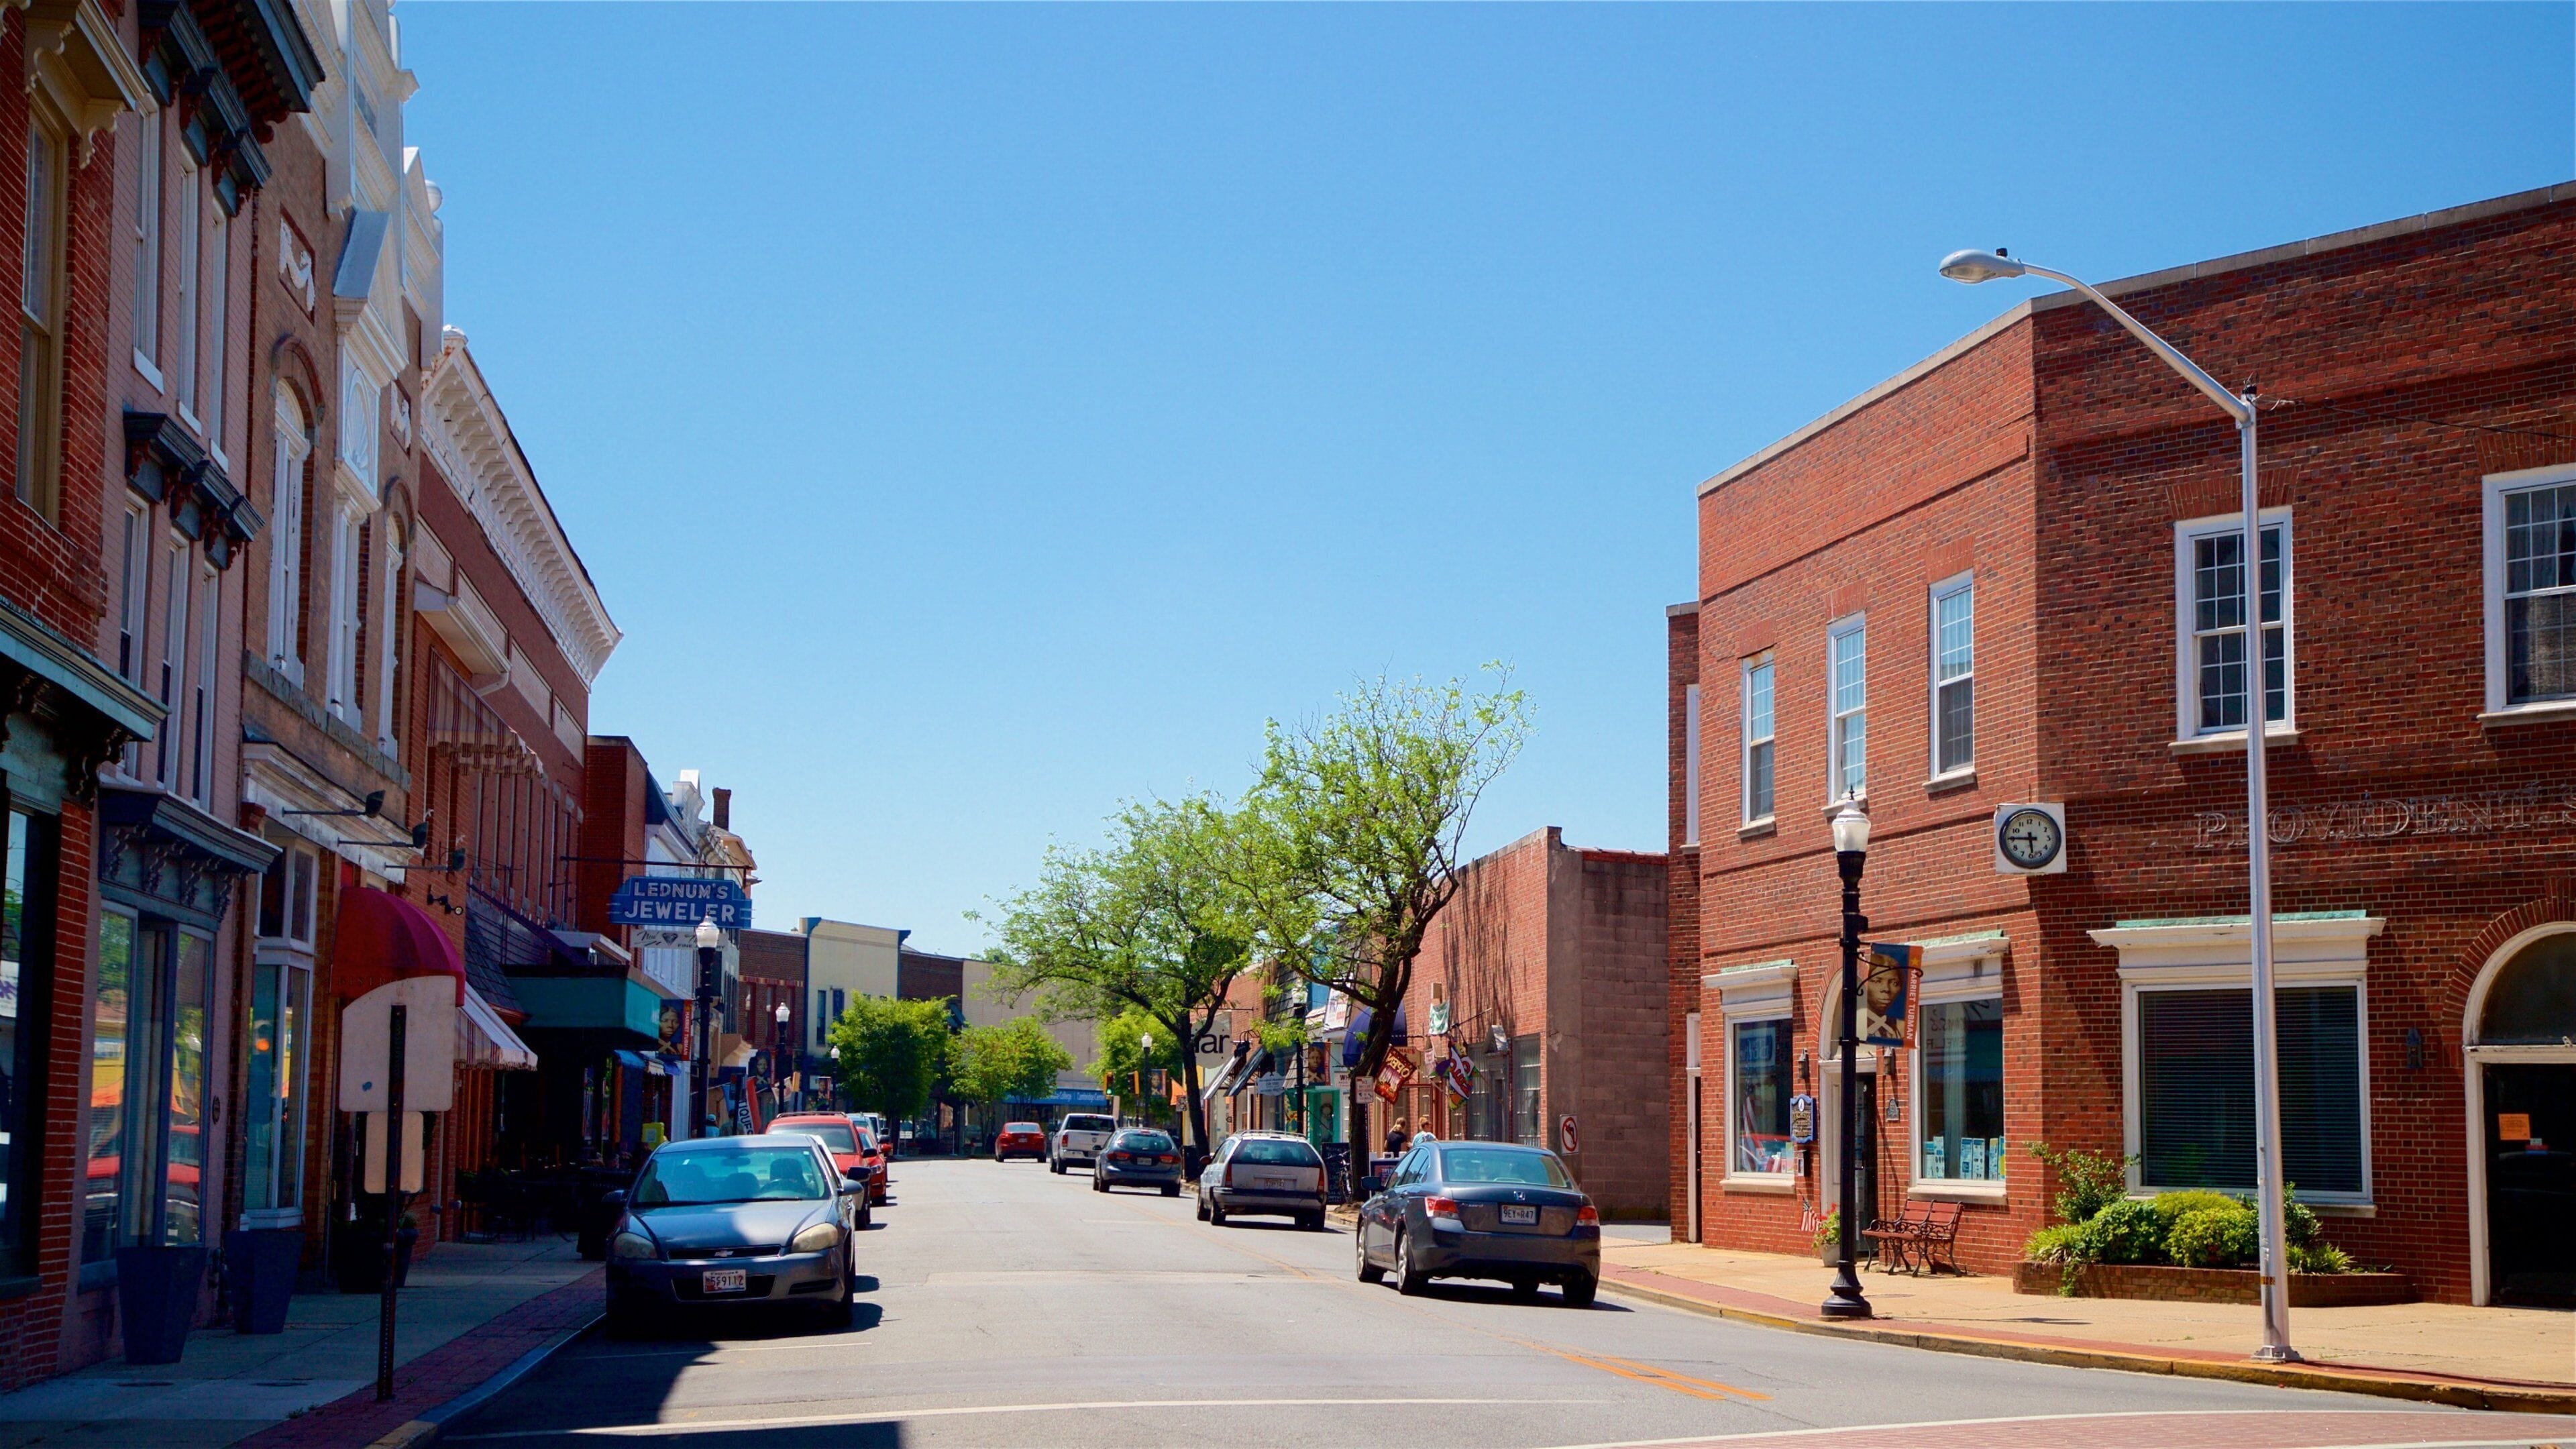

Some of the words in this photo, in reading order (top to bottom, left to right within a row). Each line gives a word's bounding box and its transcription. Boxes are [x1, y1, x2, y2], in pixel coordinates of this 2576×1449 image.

[634, 881, 729, 899] LEDNUM'S
[624, 900, 735, 922] JEWELER
[1907, 1004, 1915, 1040] TUBMAN
